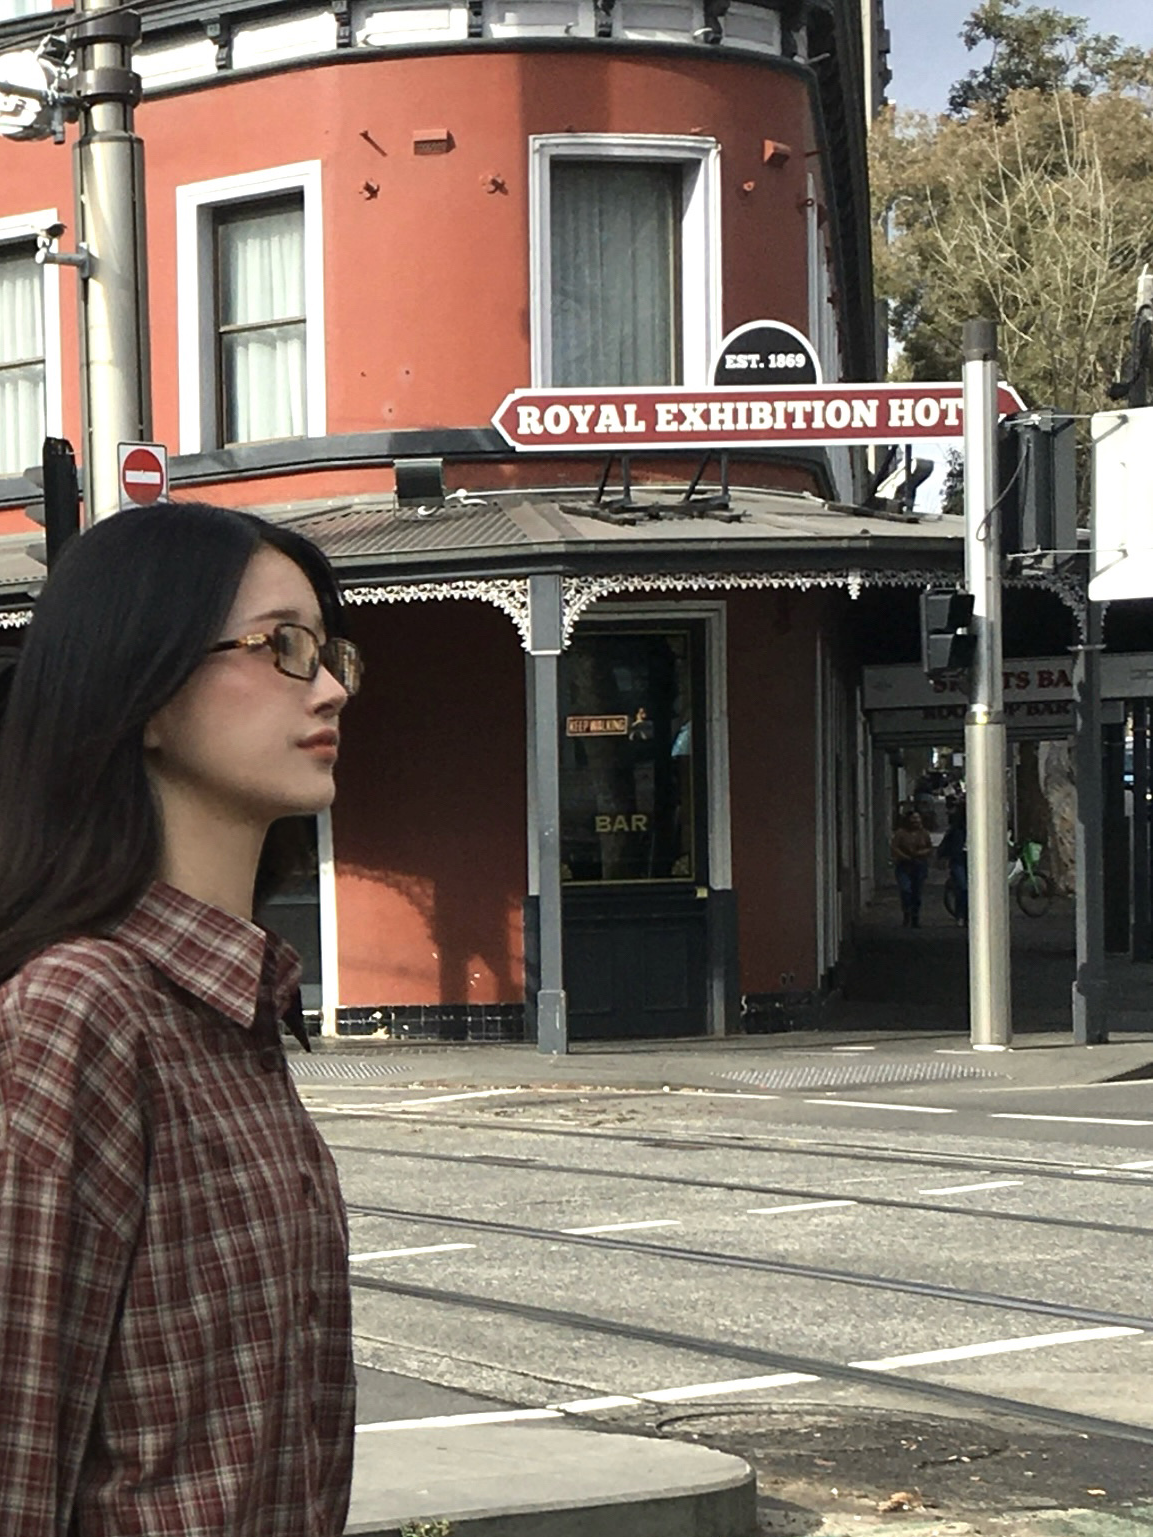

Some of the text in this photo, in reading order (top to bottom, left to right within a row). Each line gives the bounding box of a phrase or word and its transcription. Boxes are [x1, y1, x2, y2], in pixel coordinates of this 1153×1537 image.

[724, 353, 806, 369] EST. 1869
[516, 404, 646, 436] ROYAL
[654, 399, 880, 433] EXHIBITION
[1035, 668, 1072, 689] BA
[595, 813, 648, 833] BAR
